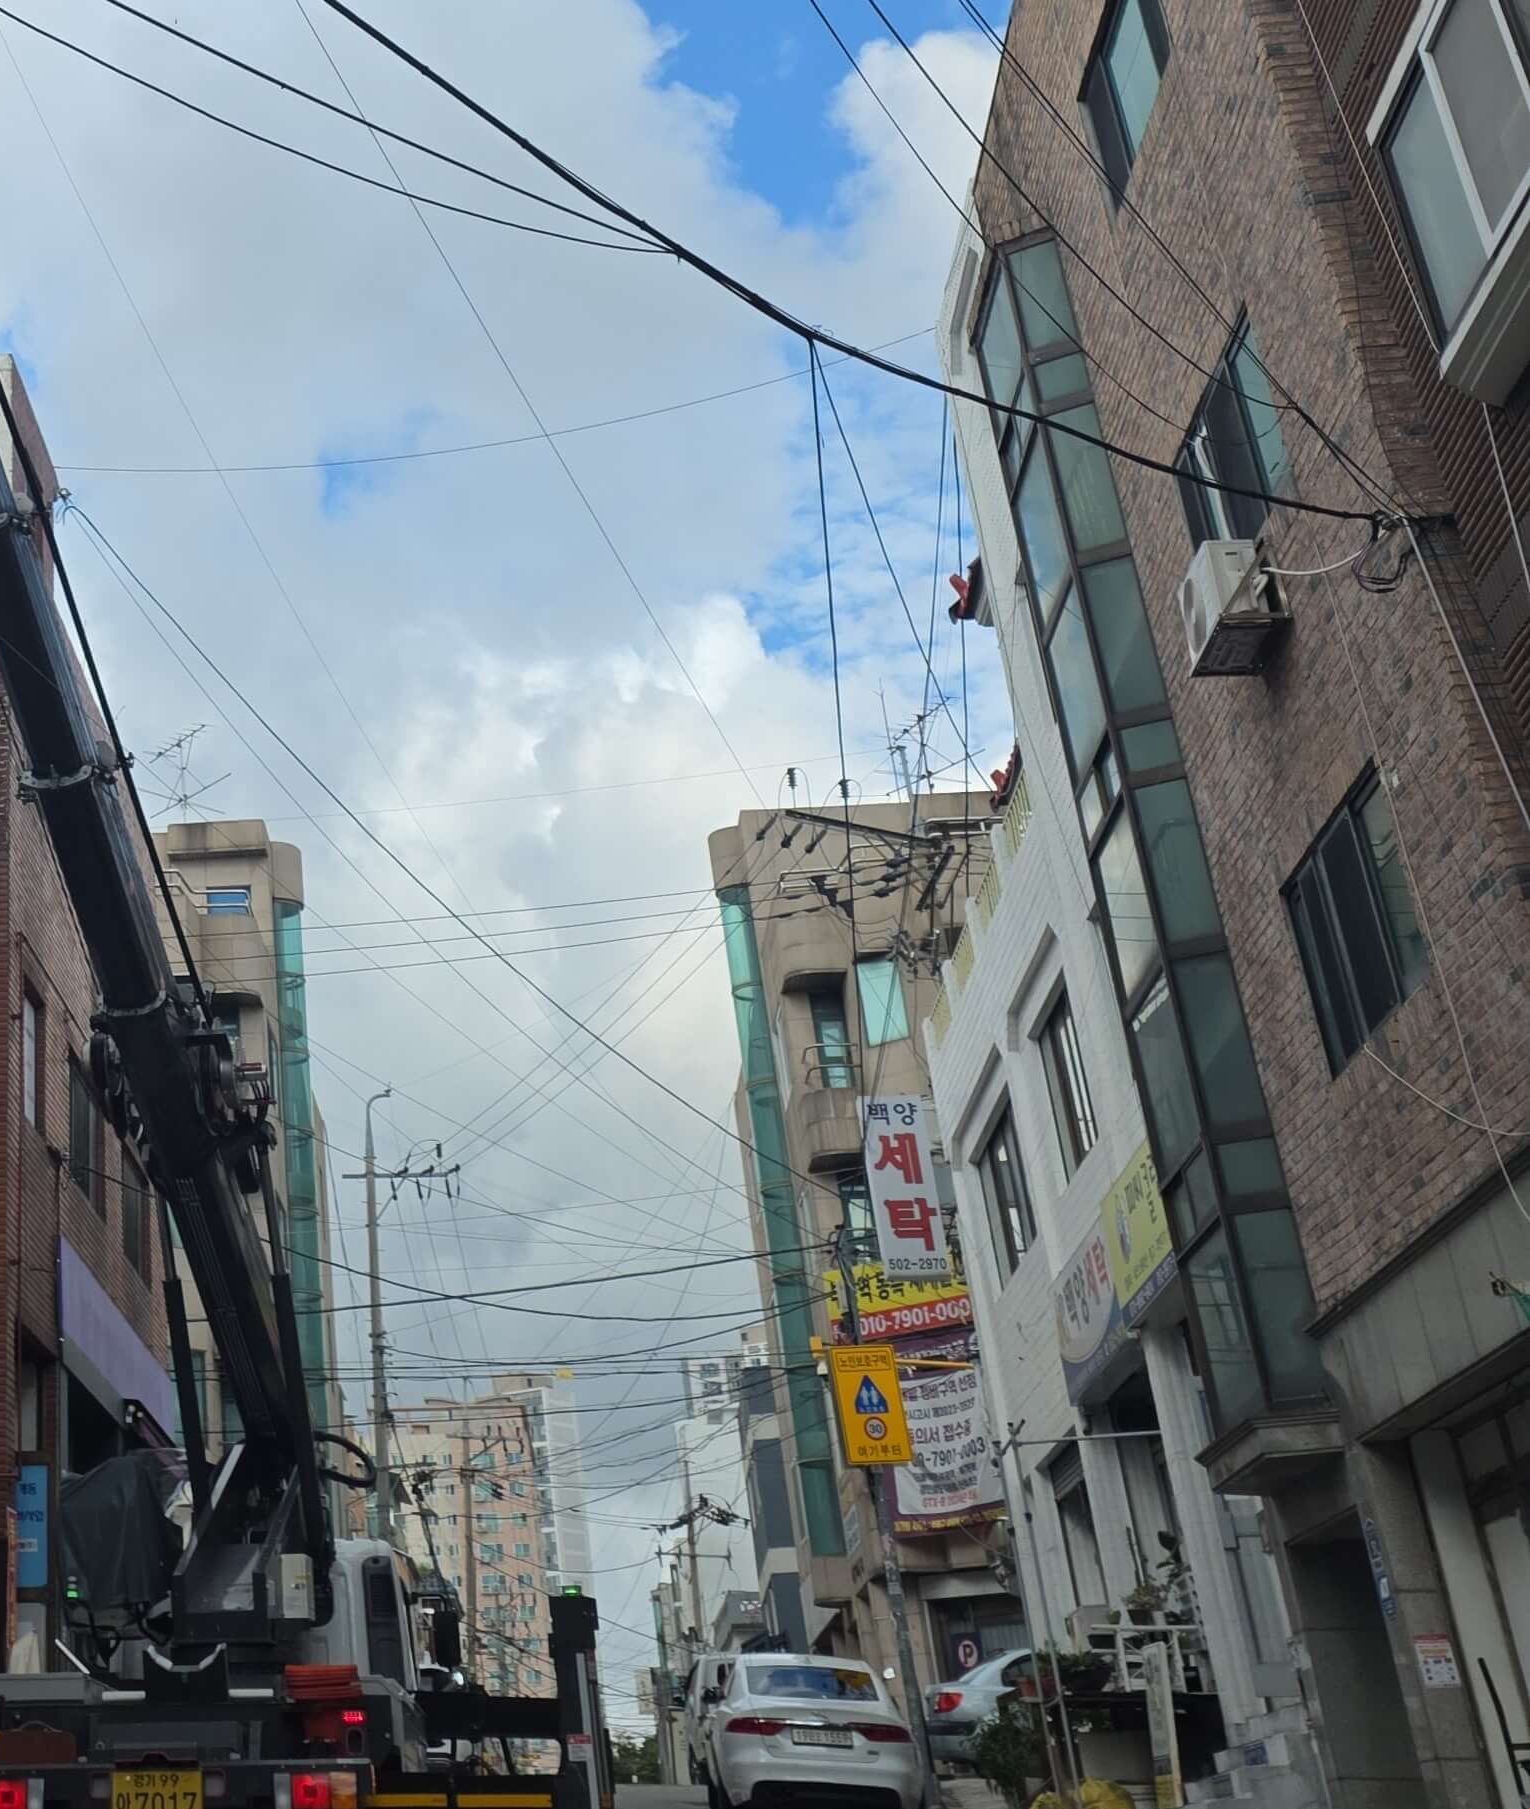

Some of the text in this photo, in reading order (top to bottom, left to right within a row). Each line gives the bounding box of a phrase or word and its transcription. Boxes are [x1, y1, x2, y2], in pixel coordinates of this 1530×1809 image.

[867, 1103, 917, 1126] 백양
[875, 1133, 937, 1251] 세탁
[889, 1257, 947, 1271] 502-2970
[869, 1423, 882, 1433] 30
[857, 1444, 903, 1456] 여기부터
